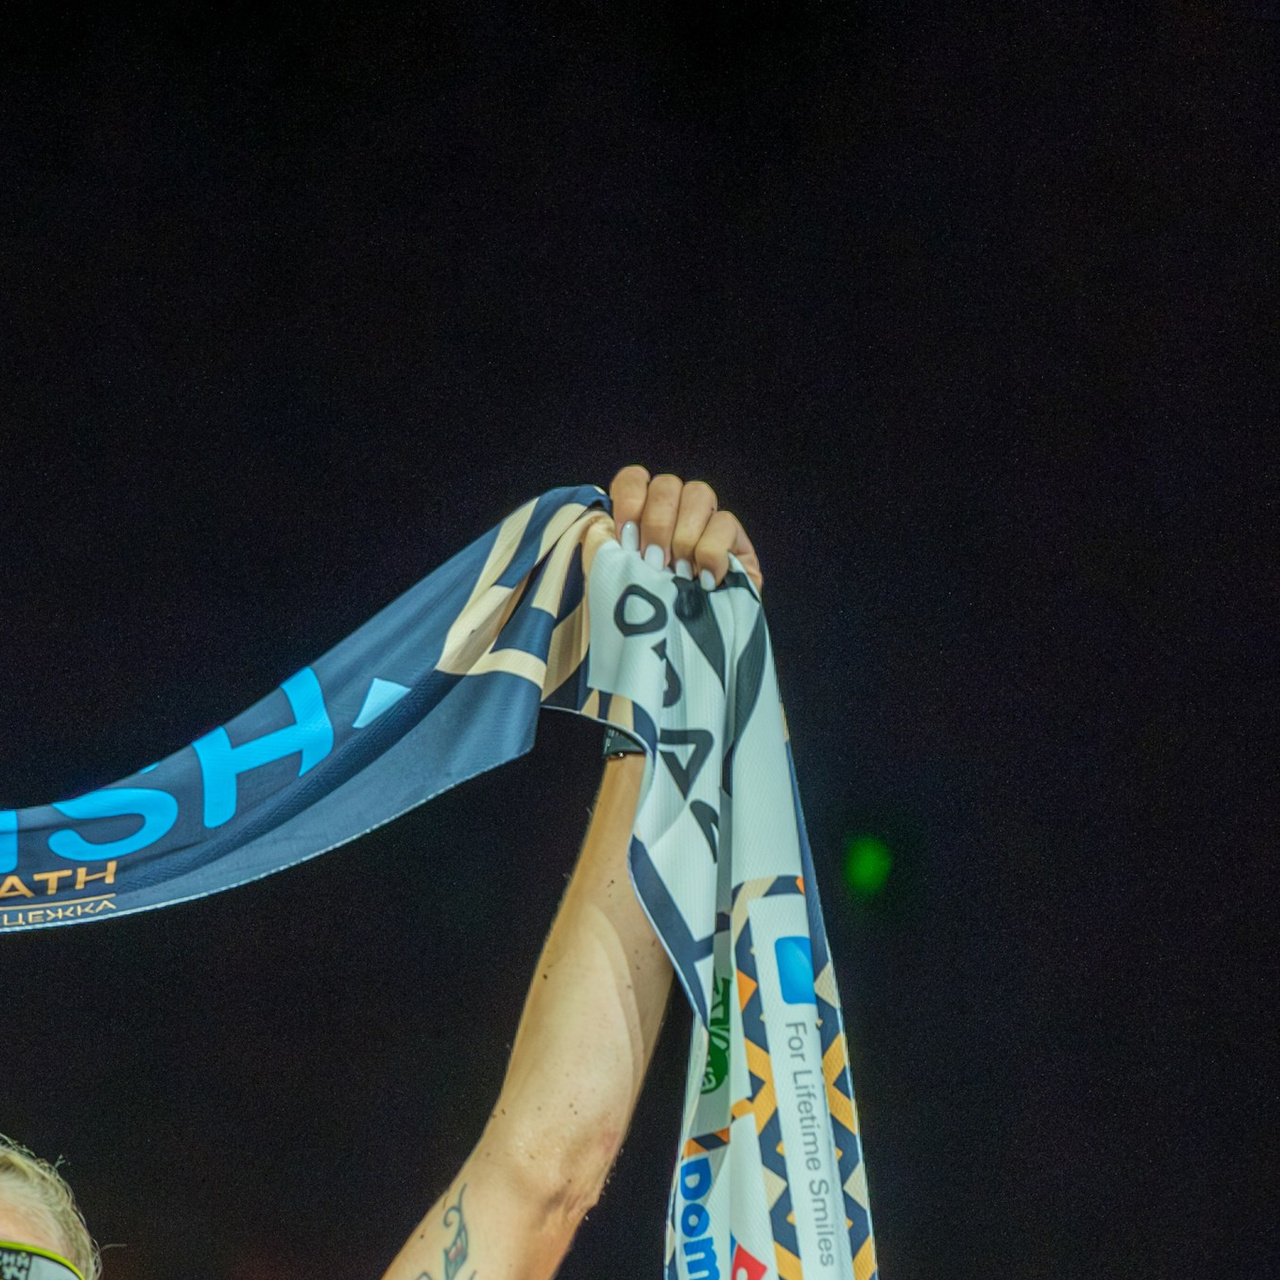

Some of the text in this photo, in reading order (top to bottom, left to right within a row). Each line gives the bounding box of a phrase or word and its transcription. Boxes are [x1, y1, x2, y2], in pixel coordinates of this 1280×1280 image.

[785, 1021, 836, 1268] For Lifetime Smiles
